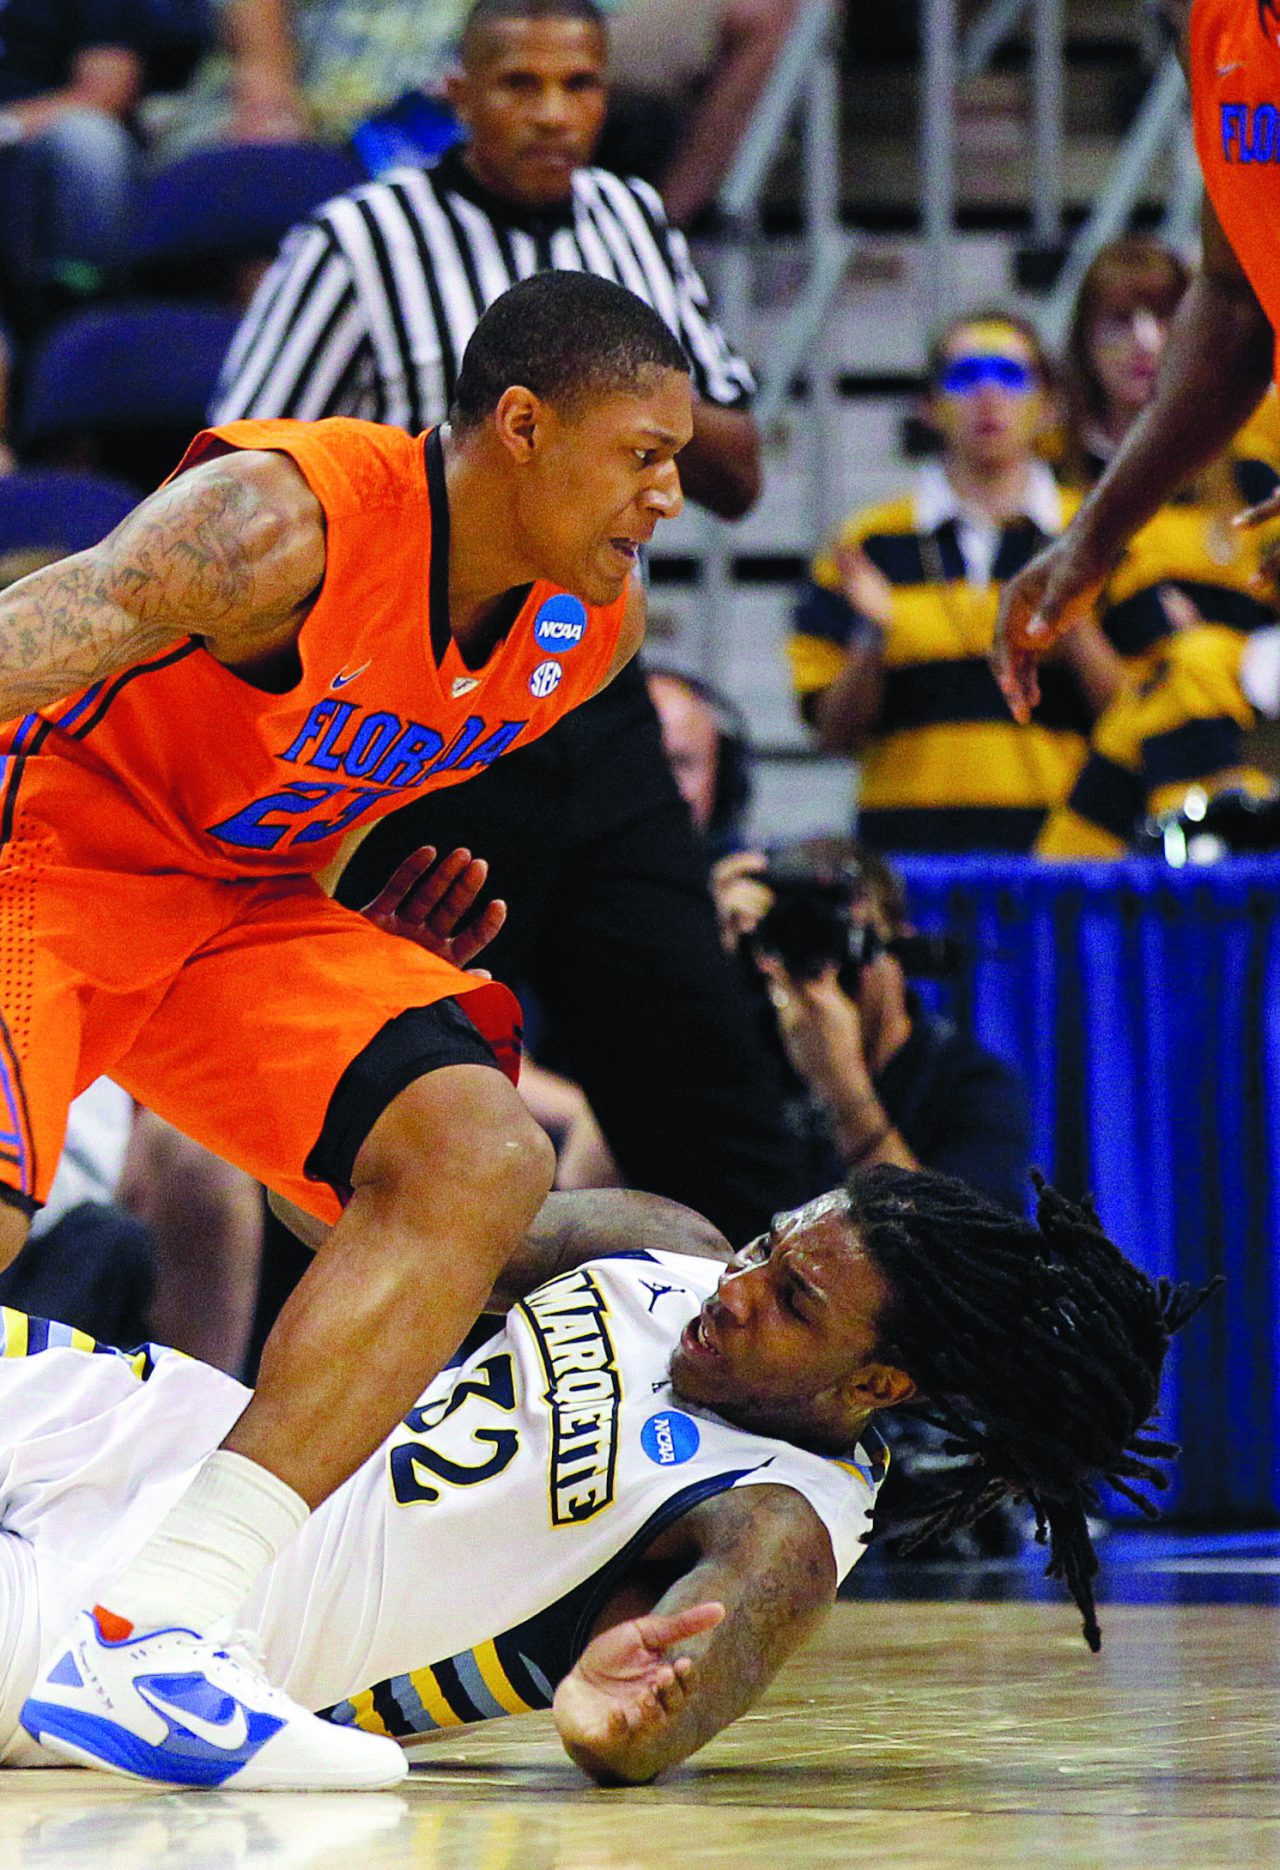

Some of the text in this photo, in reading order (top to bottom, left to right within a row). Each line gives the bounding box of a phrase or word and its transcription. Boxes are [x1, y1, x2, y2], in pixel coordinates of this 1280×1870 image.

[1221, 103, 1280, 164] FLO
[538, 620, 583, 641] NCAA
[530, 661, 562, 697] SEC
[389, 1352, 520, 1504] 32
[653, 1418, 676, 1464] NCAA
